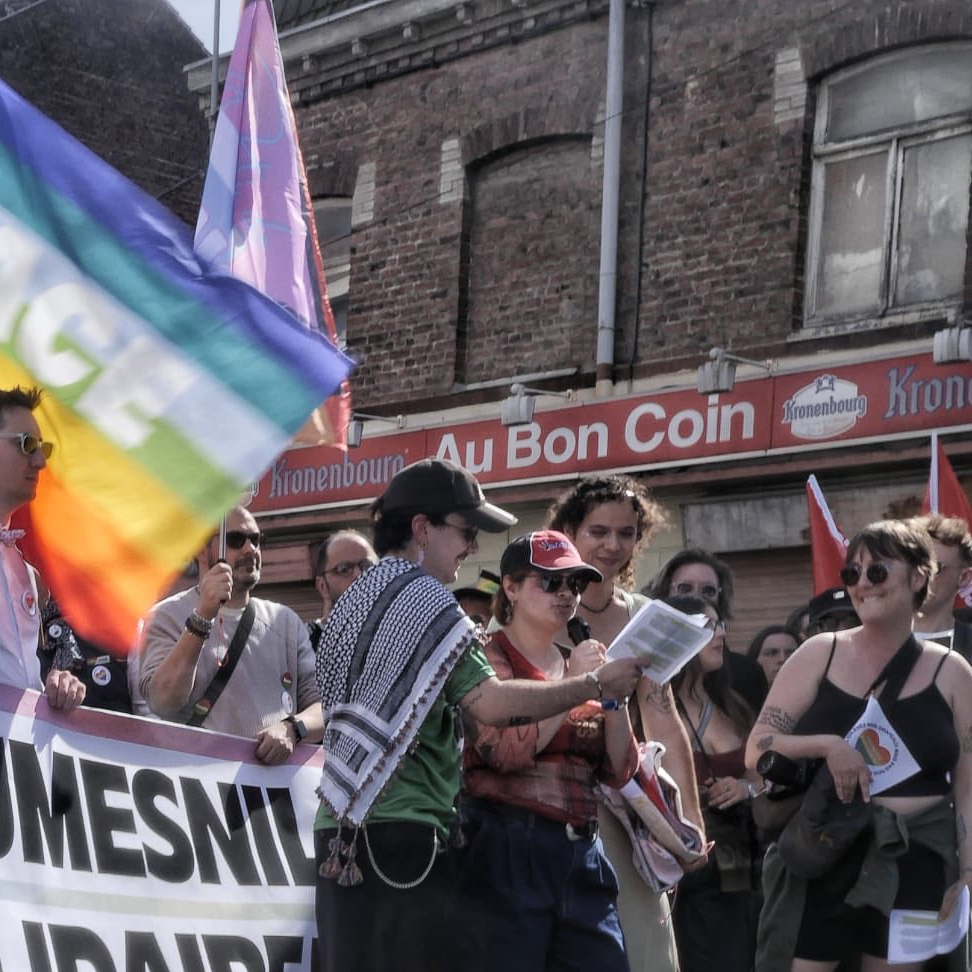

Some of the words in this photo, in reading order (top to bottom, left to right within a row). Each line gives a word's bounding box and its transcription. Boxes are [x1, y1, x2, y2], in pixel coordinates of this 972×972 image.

[783, 396, 866, 424] Kronenbourg
[883, 364, 972, 421] Kron
[436, 432, 493, 474] Au
[506, 421, 609, 470] Bon
[624, 394, 755, 454] Coin
